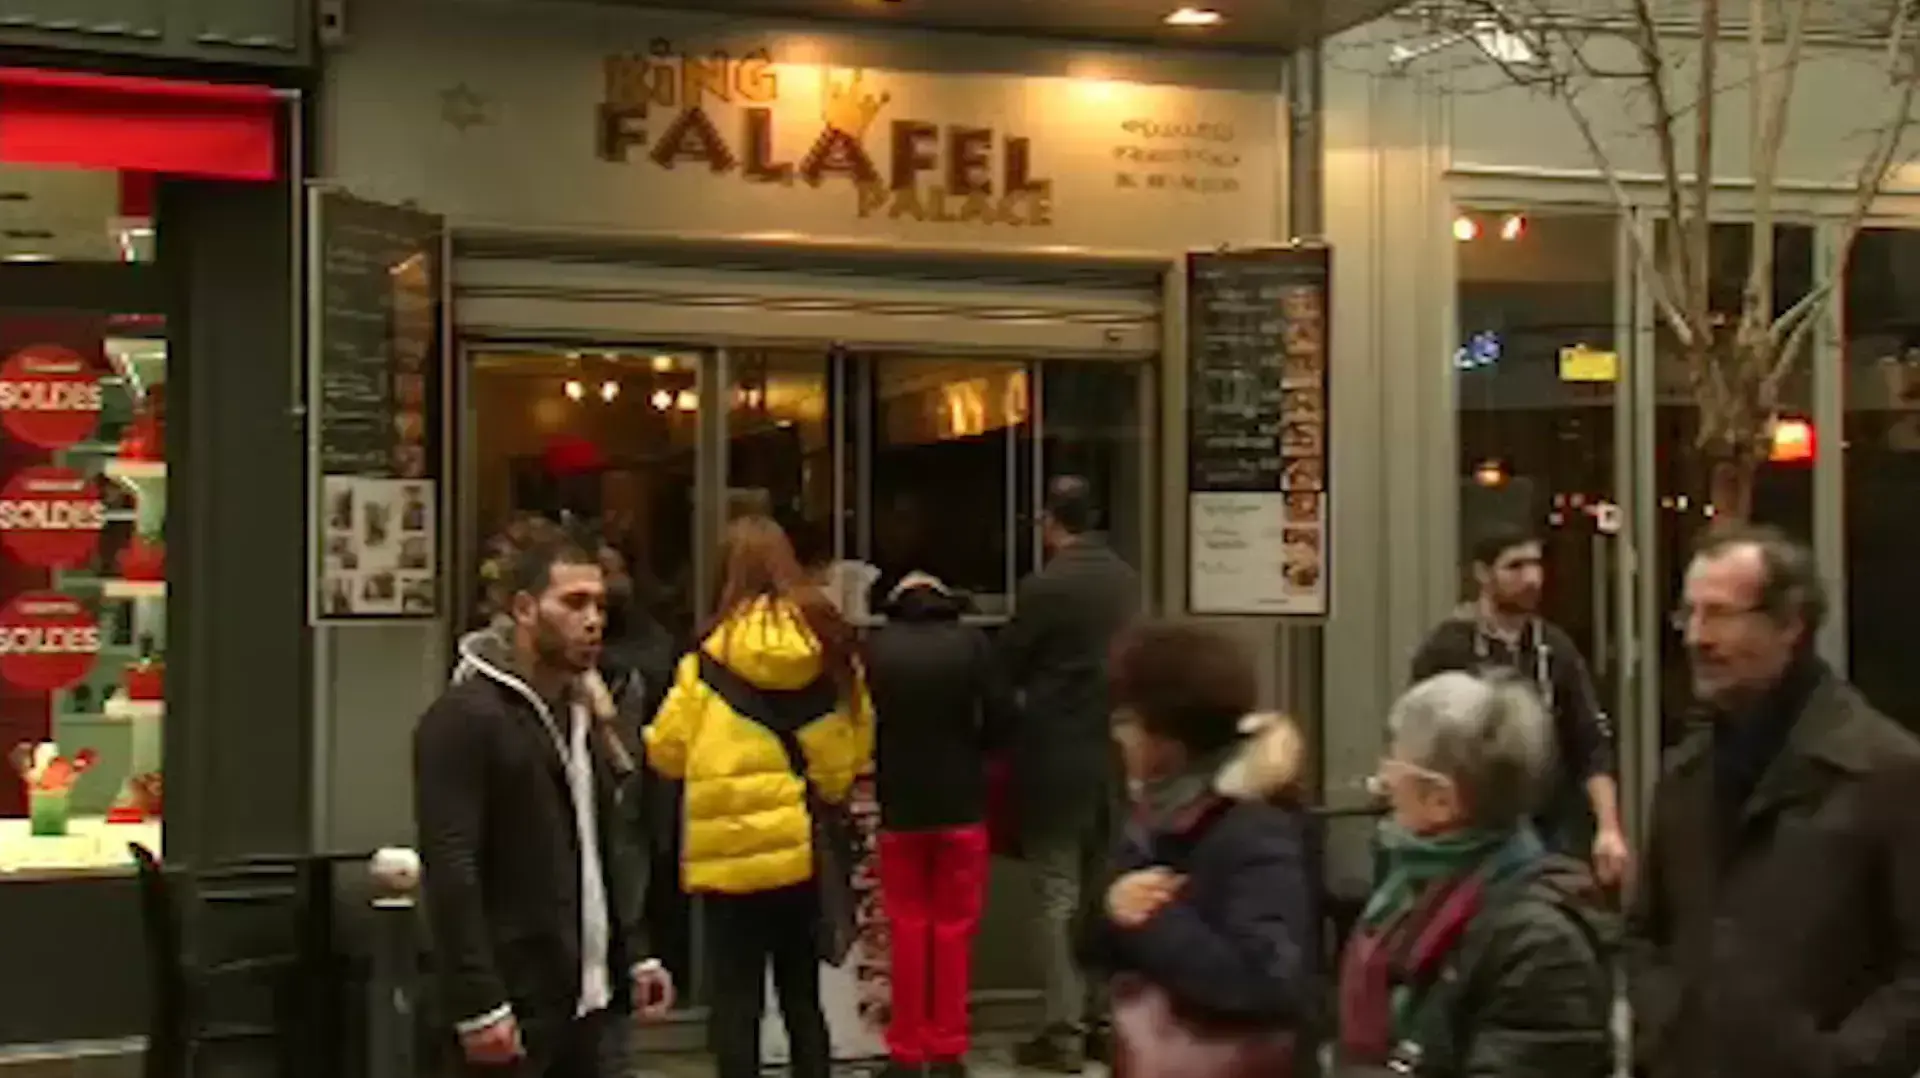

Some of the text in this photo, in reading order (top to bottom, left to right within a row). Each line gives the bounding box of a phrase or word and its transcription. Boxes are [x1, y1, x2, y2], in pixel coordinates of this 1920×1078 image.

[596, 103, 1050, 196] FALAFEL
[857, 181, 1053, 226] PALACE
[0, 381, 102, 410] SOLDES
[0, 500, 106, 530] SOLDES
